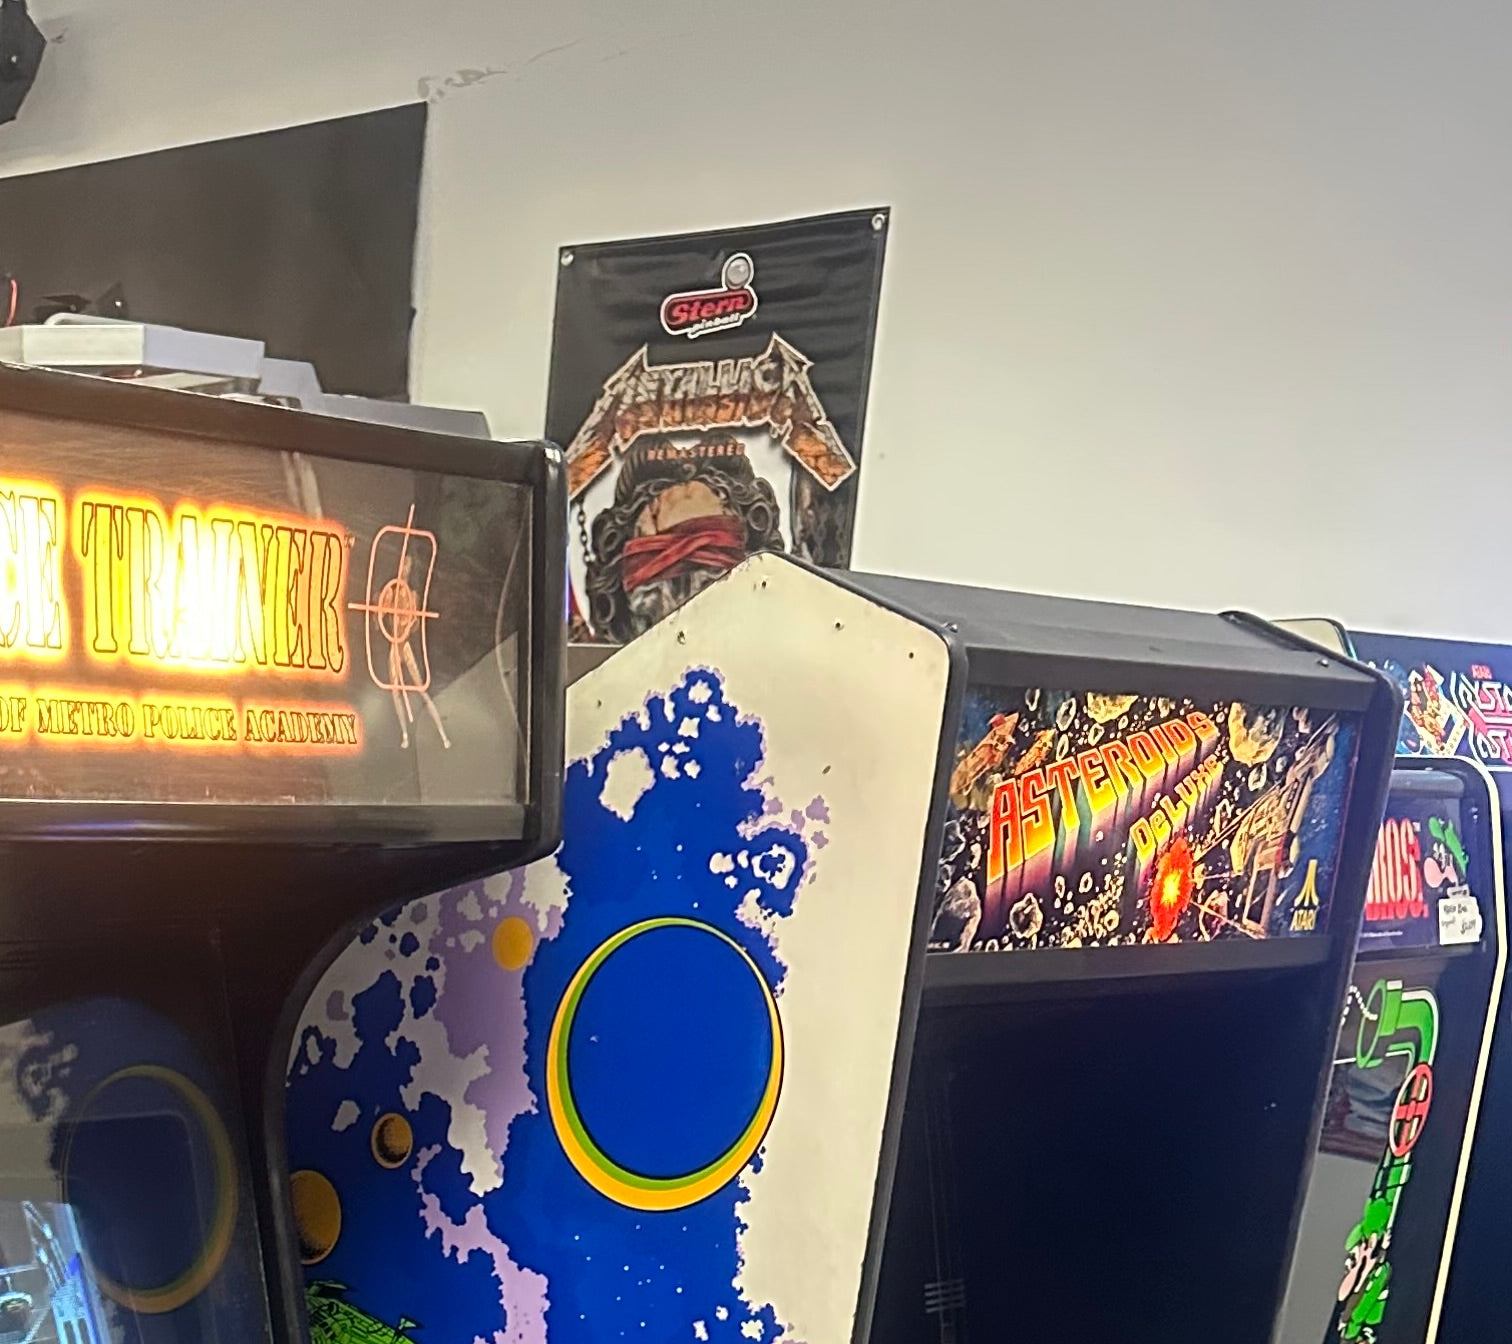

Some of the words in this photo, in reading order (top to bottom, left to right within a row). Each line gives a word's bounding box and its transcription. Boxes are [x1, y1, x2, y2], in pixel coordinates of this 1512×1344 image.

[672, 296, 745, 324] Stern
[646, 441, 747, 461] REMASTERED
[81, 501, 344, 674] TRAINER
[37, 698, 135, 737] METRO
[142, 703, 238, 741] POLICE
[244, 709, 357, 744] ACADEMY
[986, 711, 1220, 885] ASTEROIDS
[1289, 909, 1317, 931] ATARI
